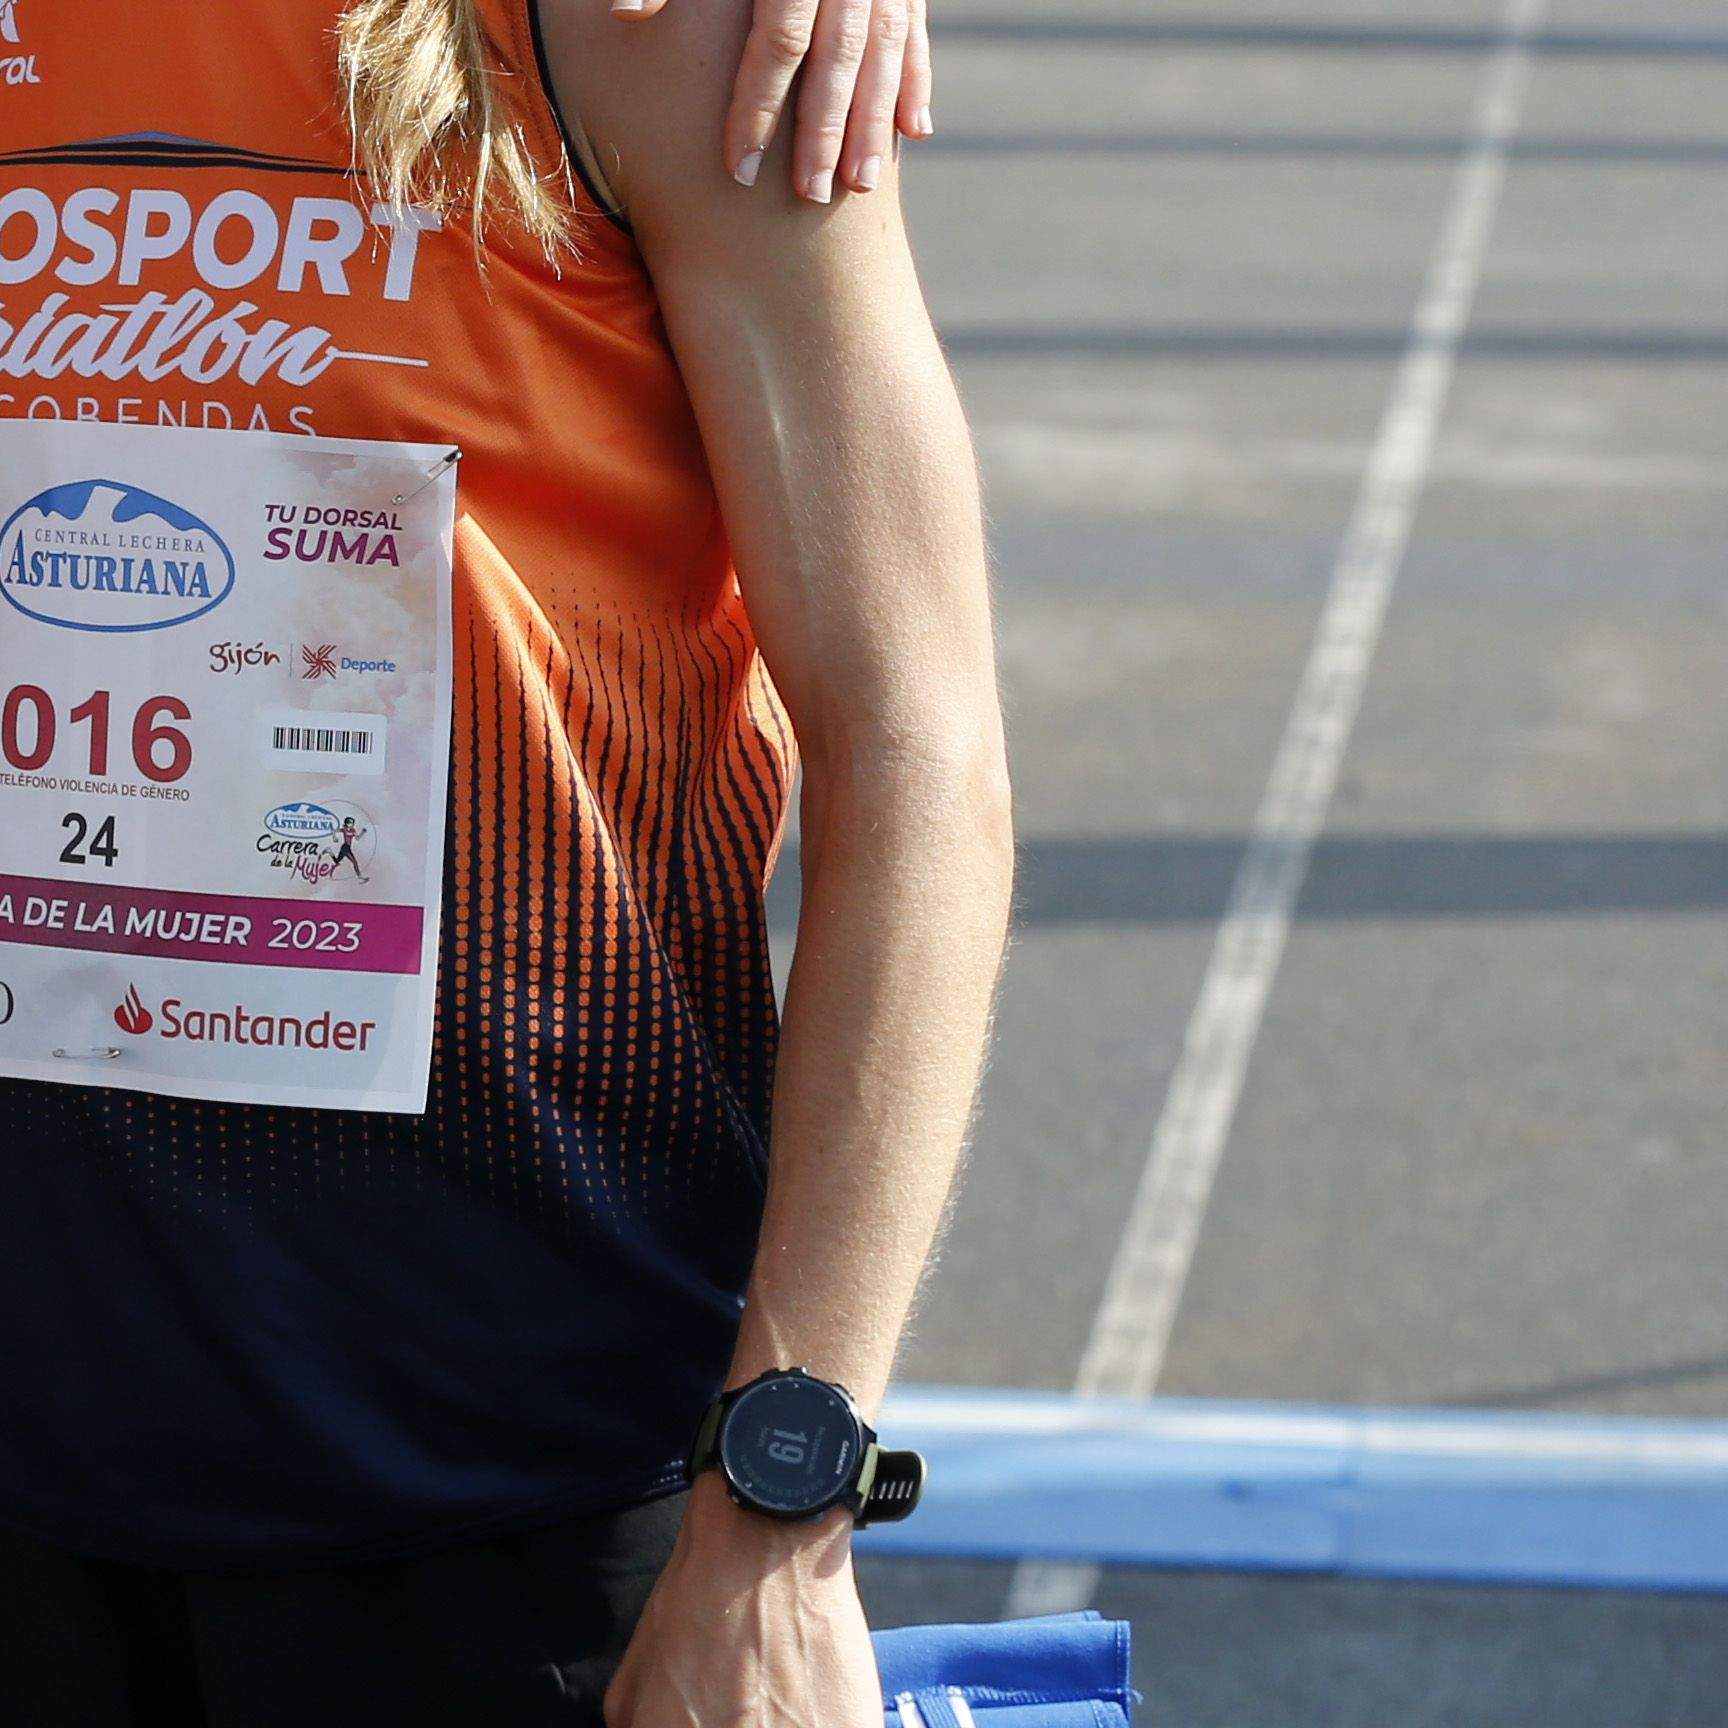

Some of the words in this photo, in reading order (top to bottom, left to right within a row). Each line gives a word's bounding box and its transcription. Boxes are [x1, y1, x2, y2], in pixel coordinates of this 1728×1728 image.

[264, 504, 297, 523] TU
[303, 506, 403, 531] DORSAL
[35, 527, 111, 546] CENTRAL
[119, 534, 205, 553] LECHERA
[263, 527, 400, 567] SUMA
[4, 529, 212, 598] ASTURIANA
[209, 642, 281, 675] gijón
[341, 657, 396, 674] Deporte
[1, 684, 193, 783] 016
[0, 772, 57, 790] TELÉFONO
[59, 778, 119, 796] VIOLENCIA
[121, 784, 138, 797] DE
[140, 784, 190, 802] GÉNERO
[270, 814, 334, 831] ASTURIANA
[59, 812, 119, 867] 24
[256, 834, 319, 855] Carrera
[290, 855, 340, 884] Mujer
[23, 896, 64, 930] DE
[74, 902, 115, 934] LA
[124, 906, 252, 946] MUJER
[268, 918, 363, 952] 2023
[160, 999, 376, 1052] Santander
